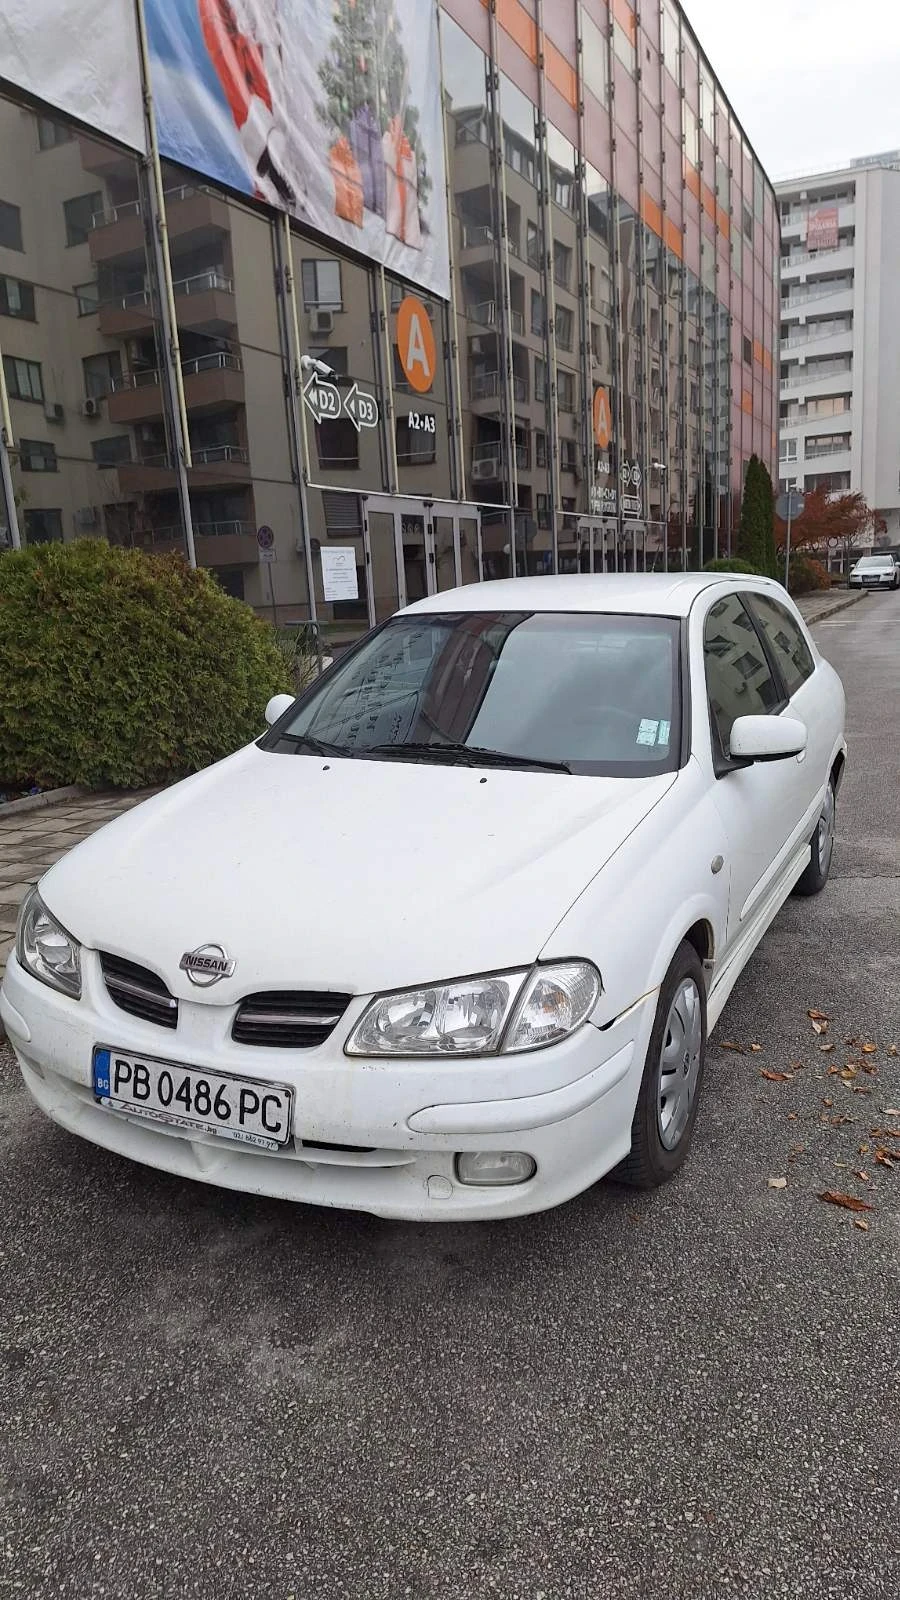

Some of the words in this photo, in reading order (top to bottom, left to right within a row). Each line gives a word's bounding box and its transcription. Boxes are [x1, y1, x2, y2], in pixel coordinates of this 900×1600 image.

[406, 313, 430, 377] A
[319, 389, 336, 412] D2
[359, 397, 373, 420] D3
[185, 955, 228, 972] NISSAN
[97, 1078, 109, 1090] BG
[114, 1060, 150, 1100] PB
[157, 1070, 231, 1121] 0486
[239, 1088, 282, 1133] PC
